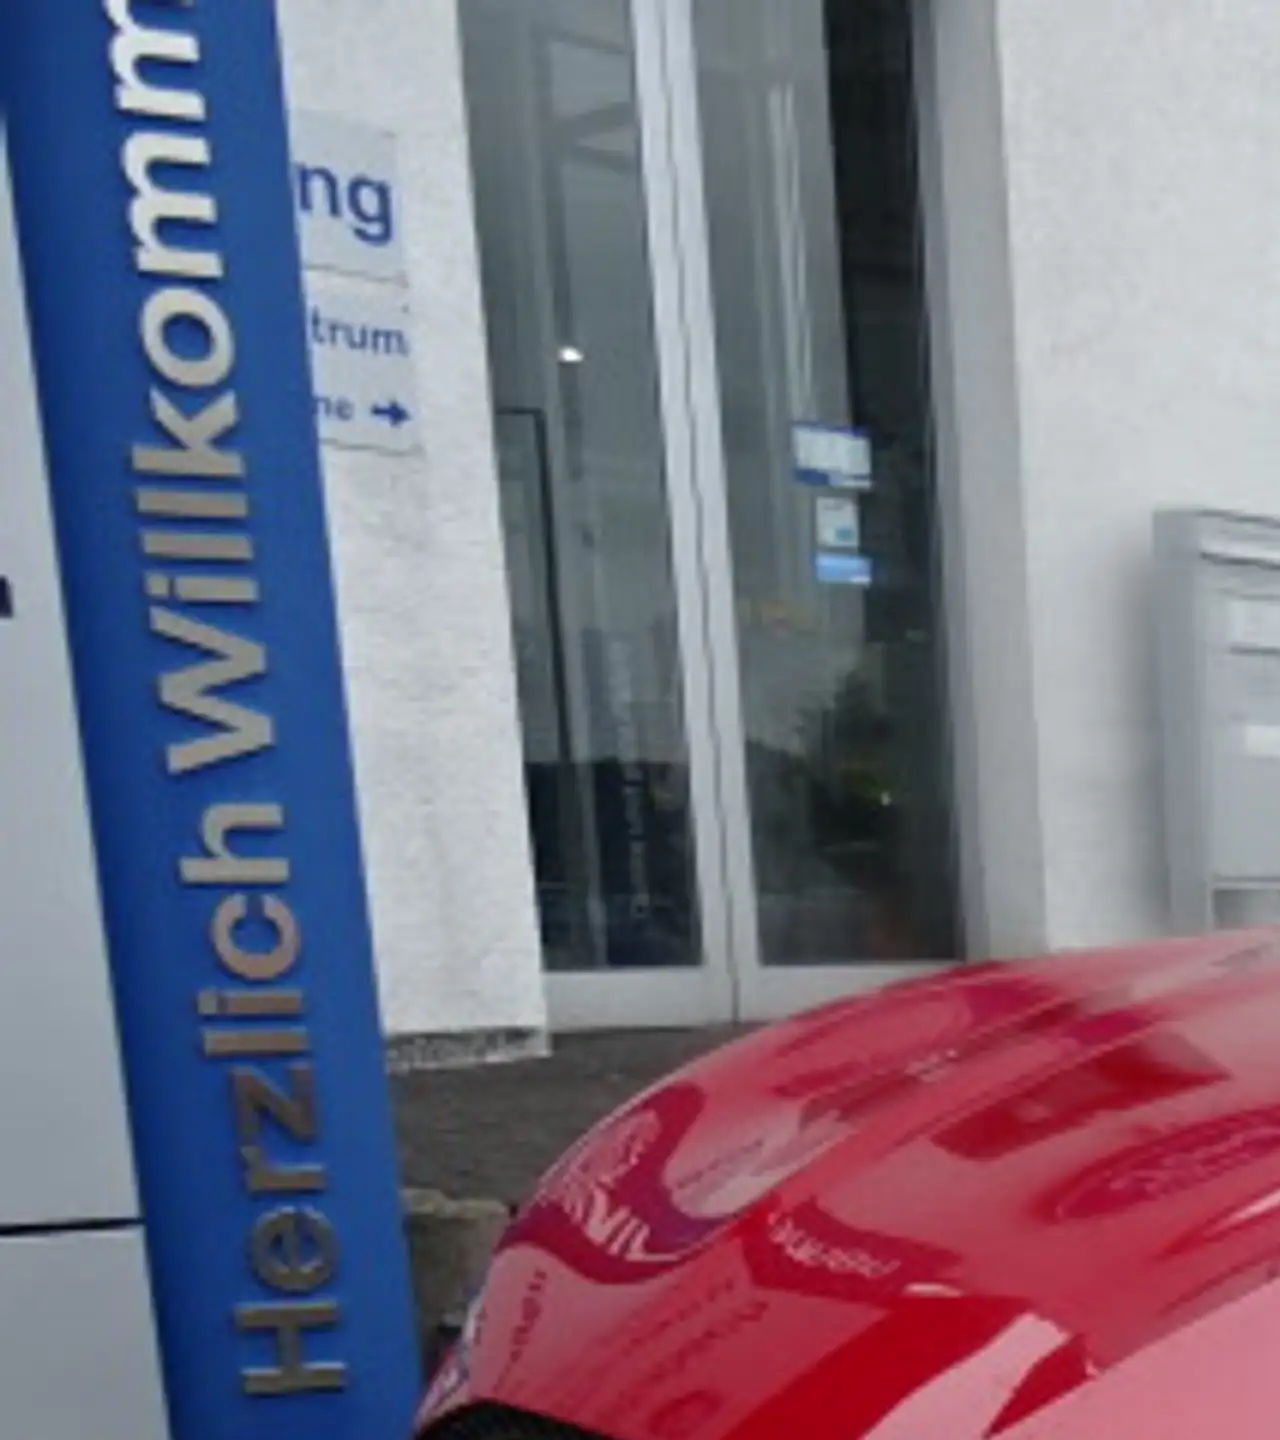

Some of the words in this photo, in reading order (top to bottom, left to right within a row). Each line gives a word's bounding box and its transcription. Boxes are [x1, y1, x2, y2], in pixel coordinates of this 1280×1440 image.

[296, 163, 392, 247] ng
[311, 304, 409, 358] trum
[178, 803, 346, 1394] Herzlich
